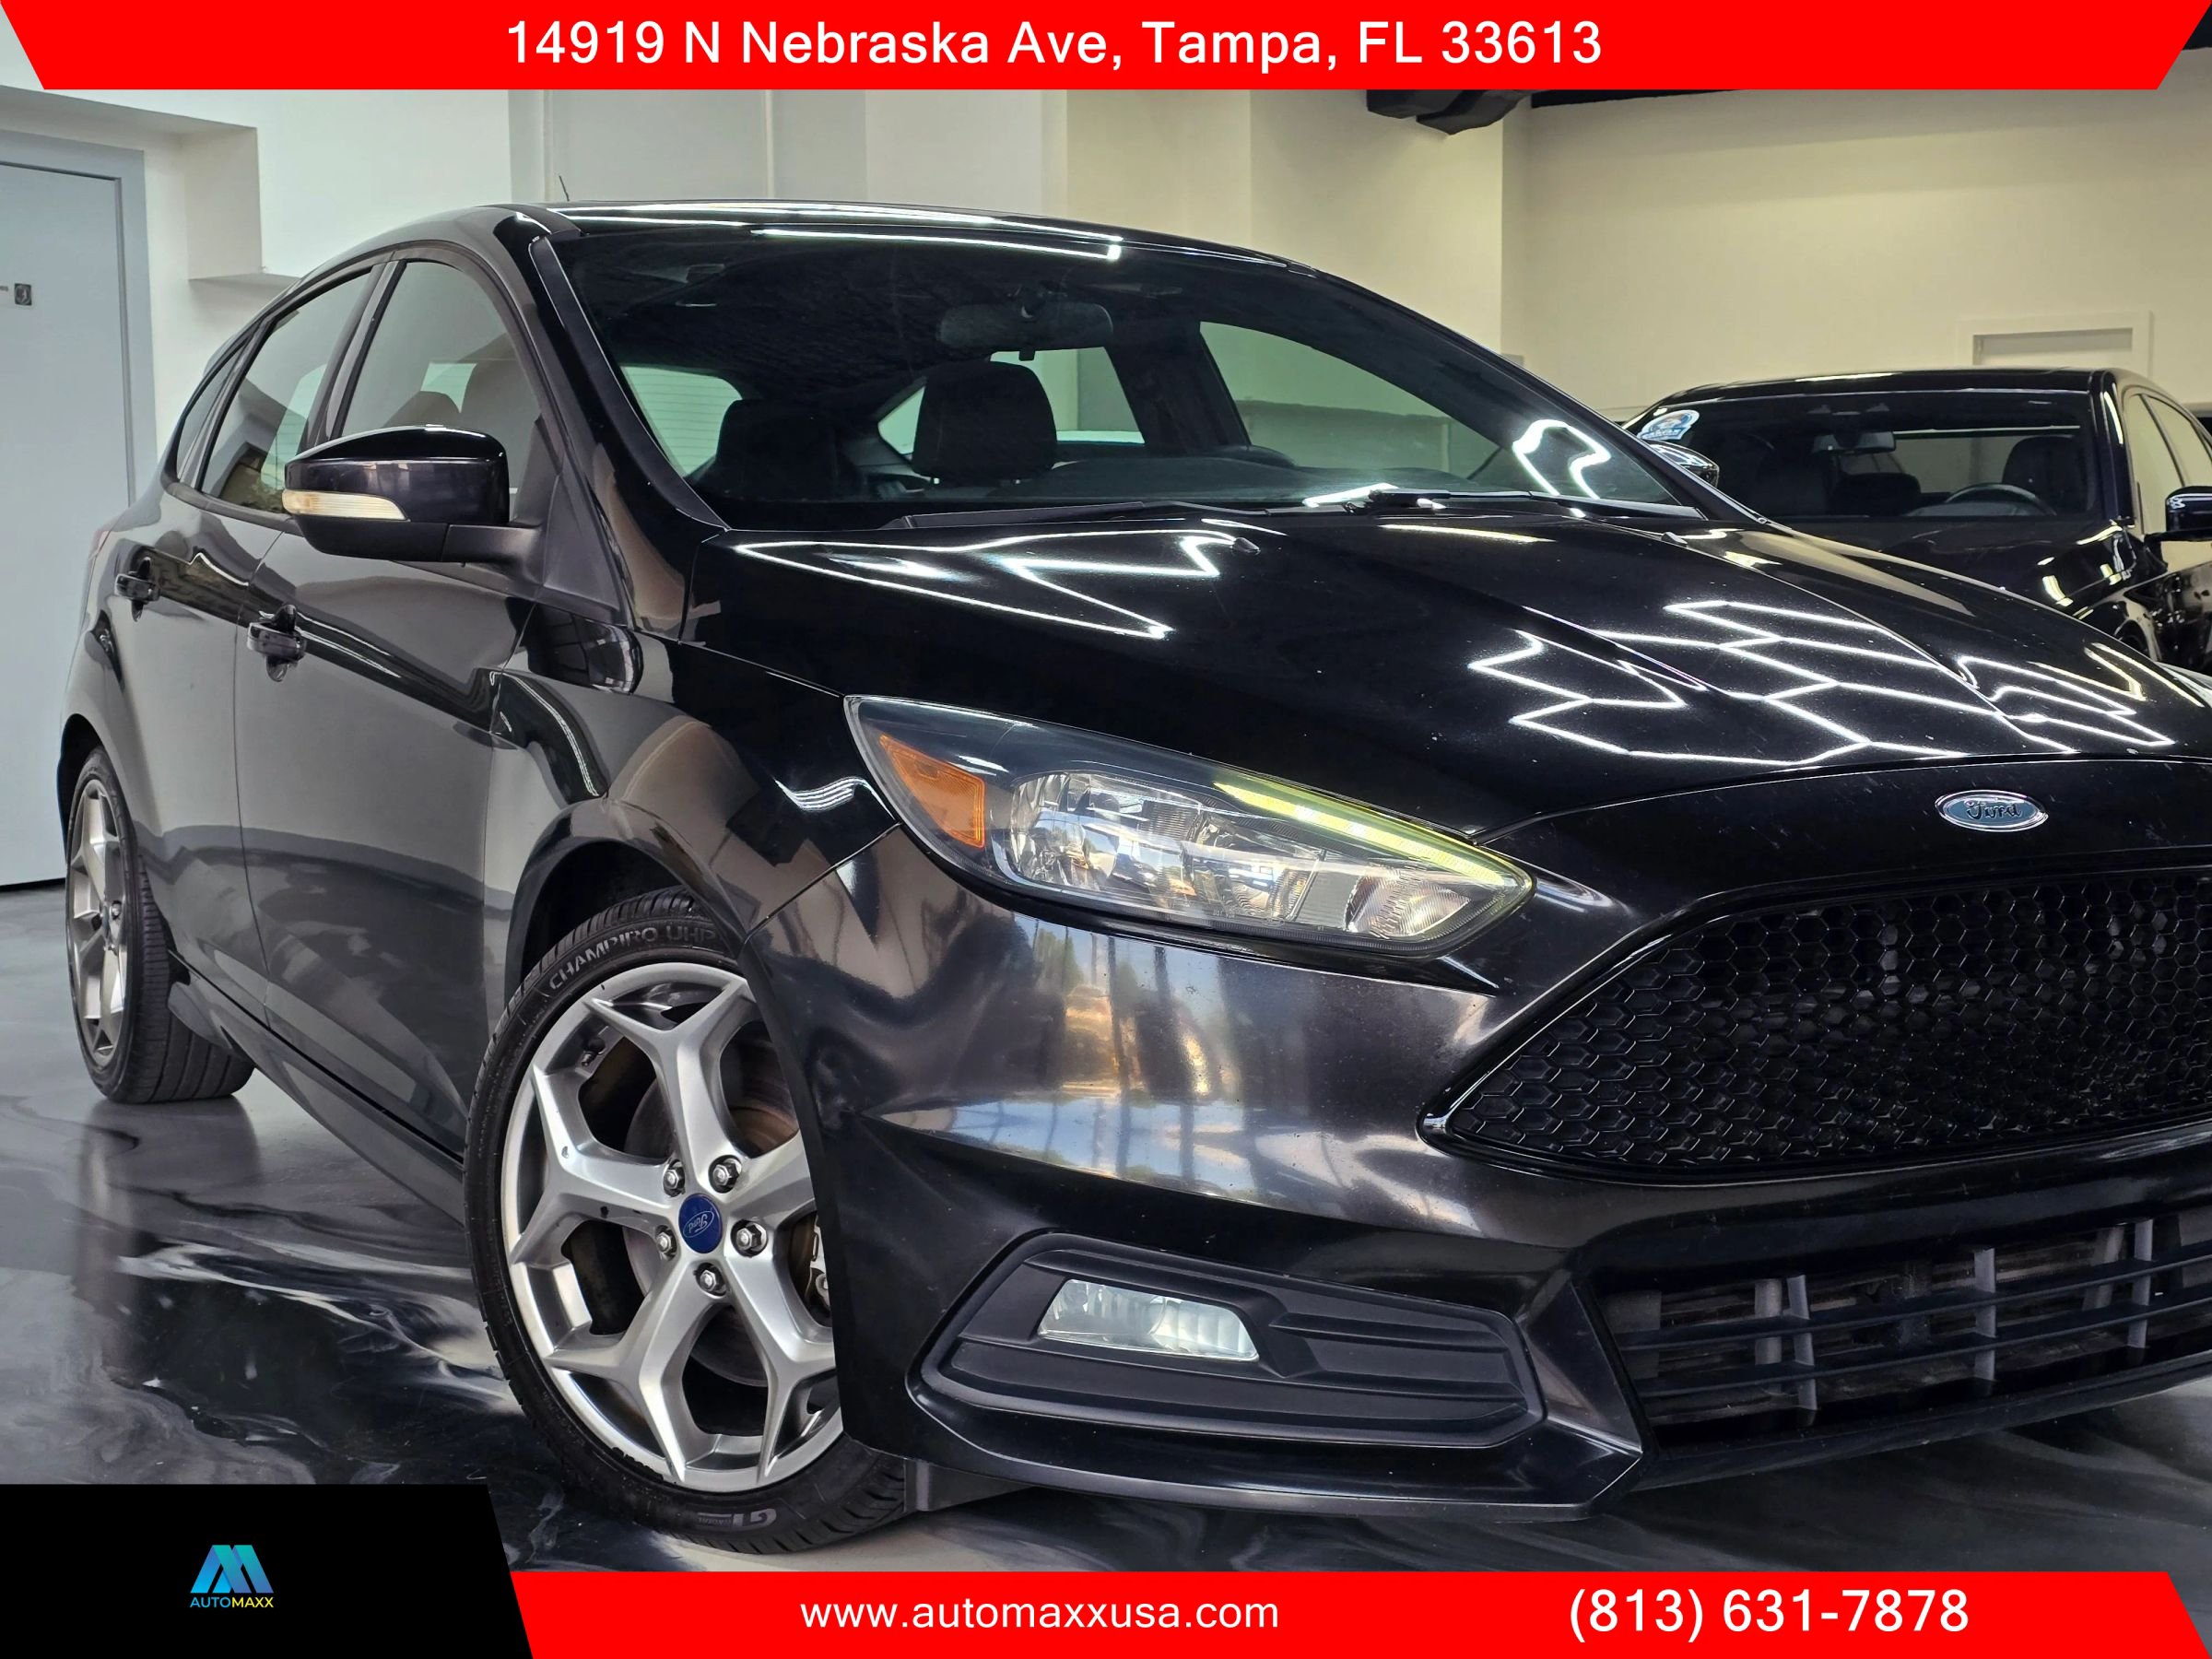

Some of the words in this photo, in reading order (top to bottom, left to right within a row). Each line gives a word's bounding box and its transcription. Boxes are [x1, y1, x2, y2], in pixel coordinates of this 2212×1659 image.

[1964, 799, 2022, 820] Ford
[549, 927, 658, 989] CHAMPIRO
[666, 925, 717, 943] UHP
[688, 1213, 709, 1234] Ford
